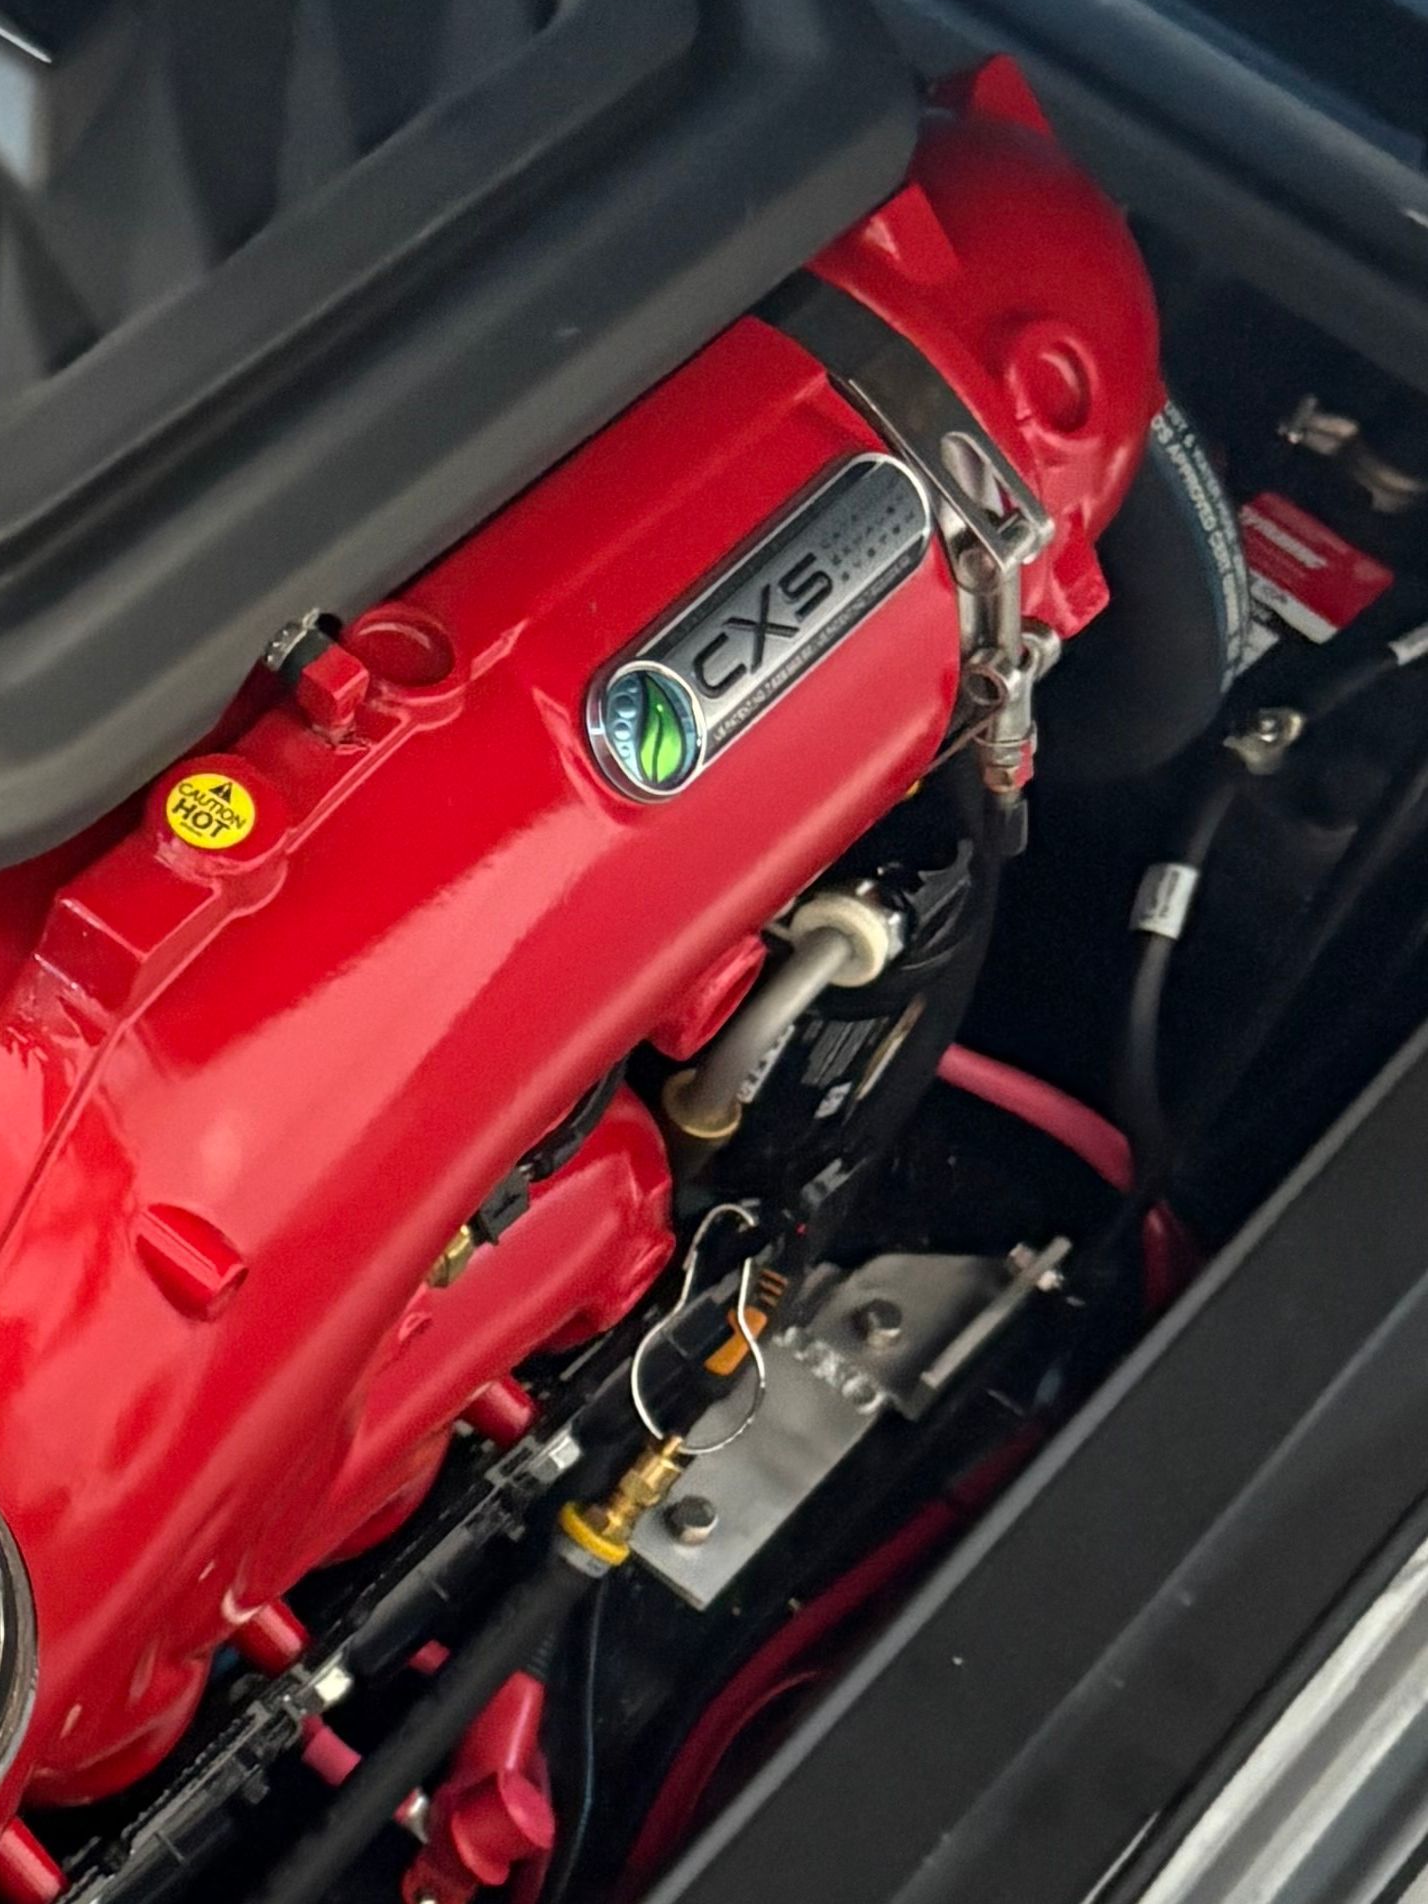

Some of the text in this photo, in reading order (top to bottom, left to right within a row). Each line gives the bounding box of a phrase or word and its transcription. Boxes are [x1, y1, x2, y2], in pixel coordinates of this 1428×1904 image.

[1166, 443, 1215, 532] APPROVED
[696, 552, 836, 701] CXS
[172, 797, 231, 837] HOT
[178, 783, 246, 829] CAUTION
